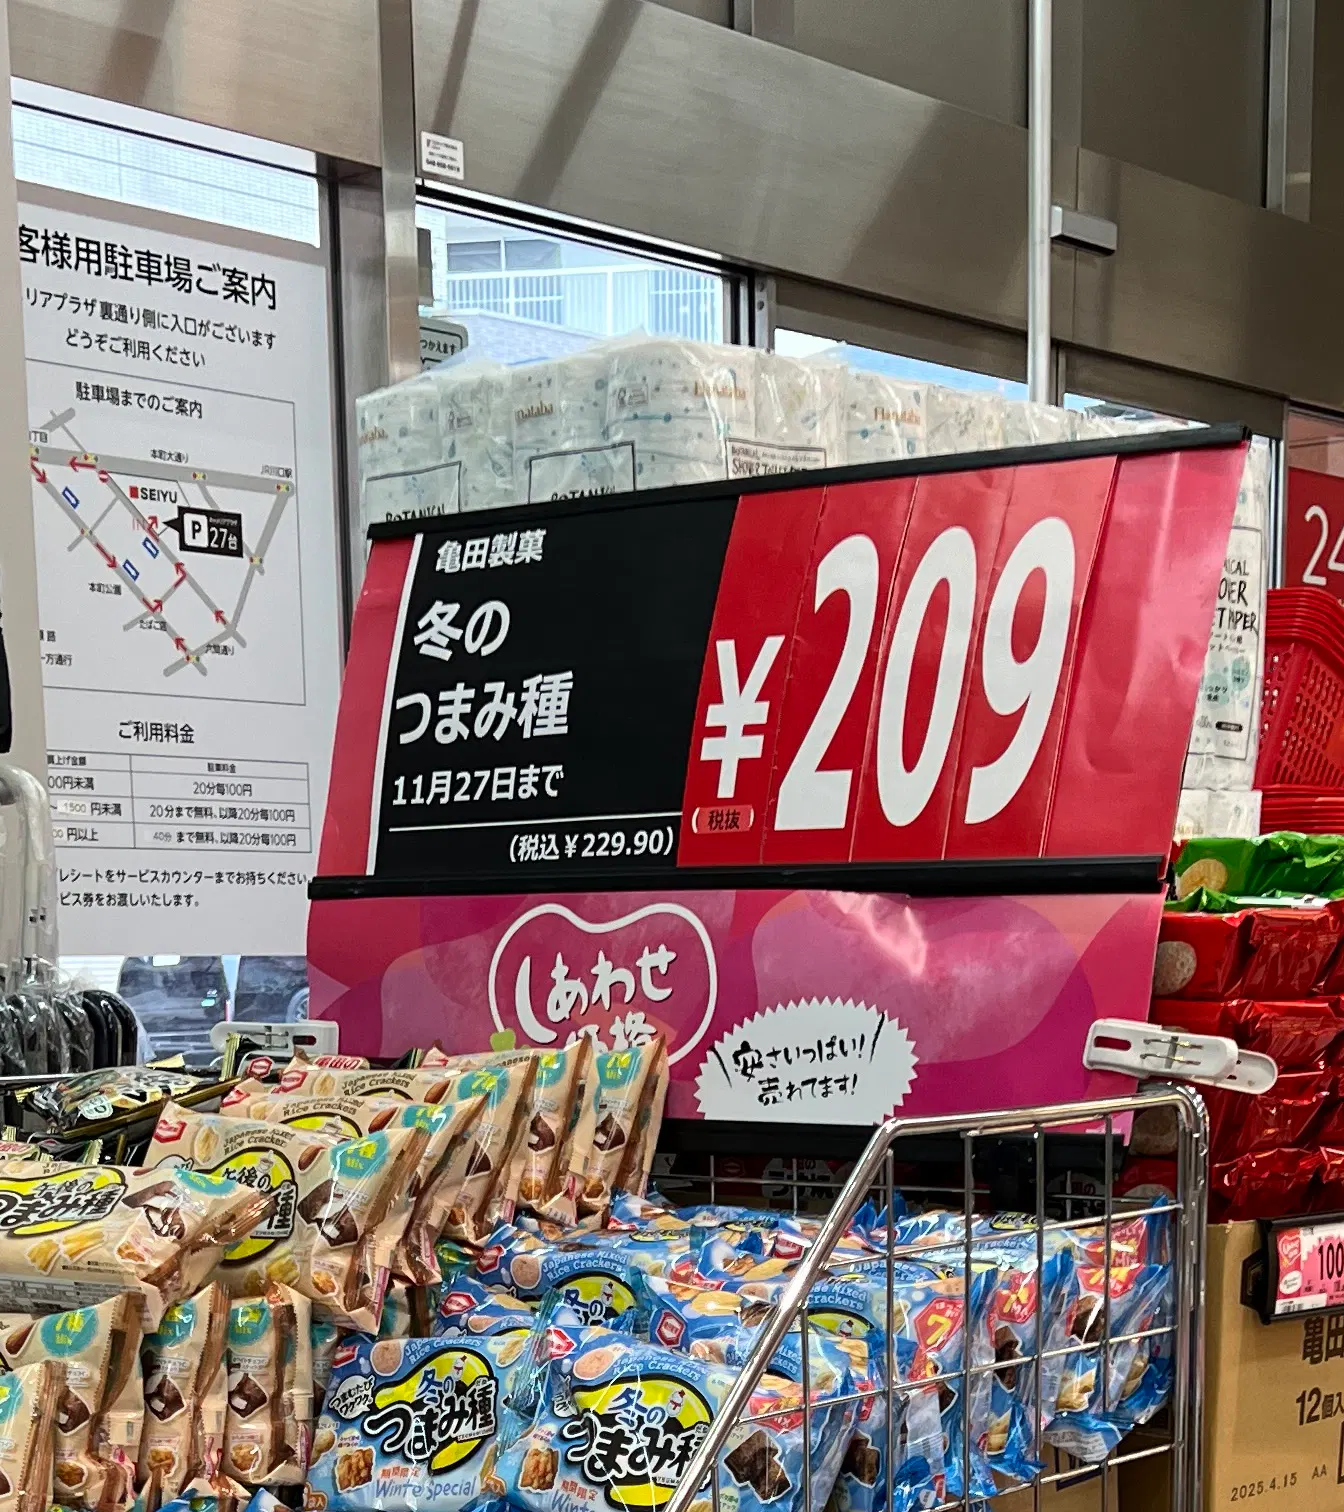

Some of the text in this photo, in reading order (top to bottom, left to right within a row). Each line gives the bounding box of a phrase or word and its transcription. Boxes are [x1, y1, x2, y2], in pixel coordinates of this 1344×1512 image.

[66, 328, 205, 368] どうぞご利用ください
[75, 382, 203, 419] 駐車場までのご案内
[140, 487, 178, 503] SEIYU
[434, 529, 547, 575] 亀田製菓
[413, 600, 510, 659] 冬の
[395, 669, 573, 745] つまみ種
[119, 720, 195, 745] ご利用料金
[193, 782, 253, 797] 20分毎100円
[392, 764, 564, 805] 11月27日まで
[67, 827, 99, 842] 円以上
[516, 945, 677, 1044] しあわせ
[1319, 1242, 1343, 1280] 100
[416, 1368, 454, 1404] 冬の
[365, 1382, 494, 1458] つまみ種
[609, 1388, 665, 1426] 冬の
[1297, 1388, 1344, 1425] 12個入
[1232, 1473, 1297, 1501] 2025.4.15
